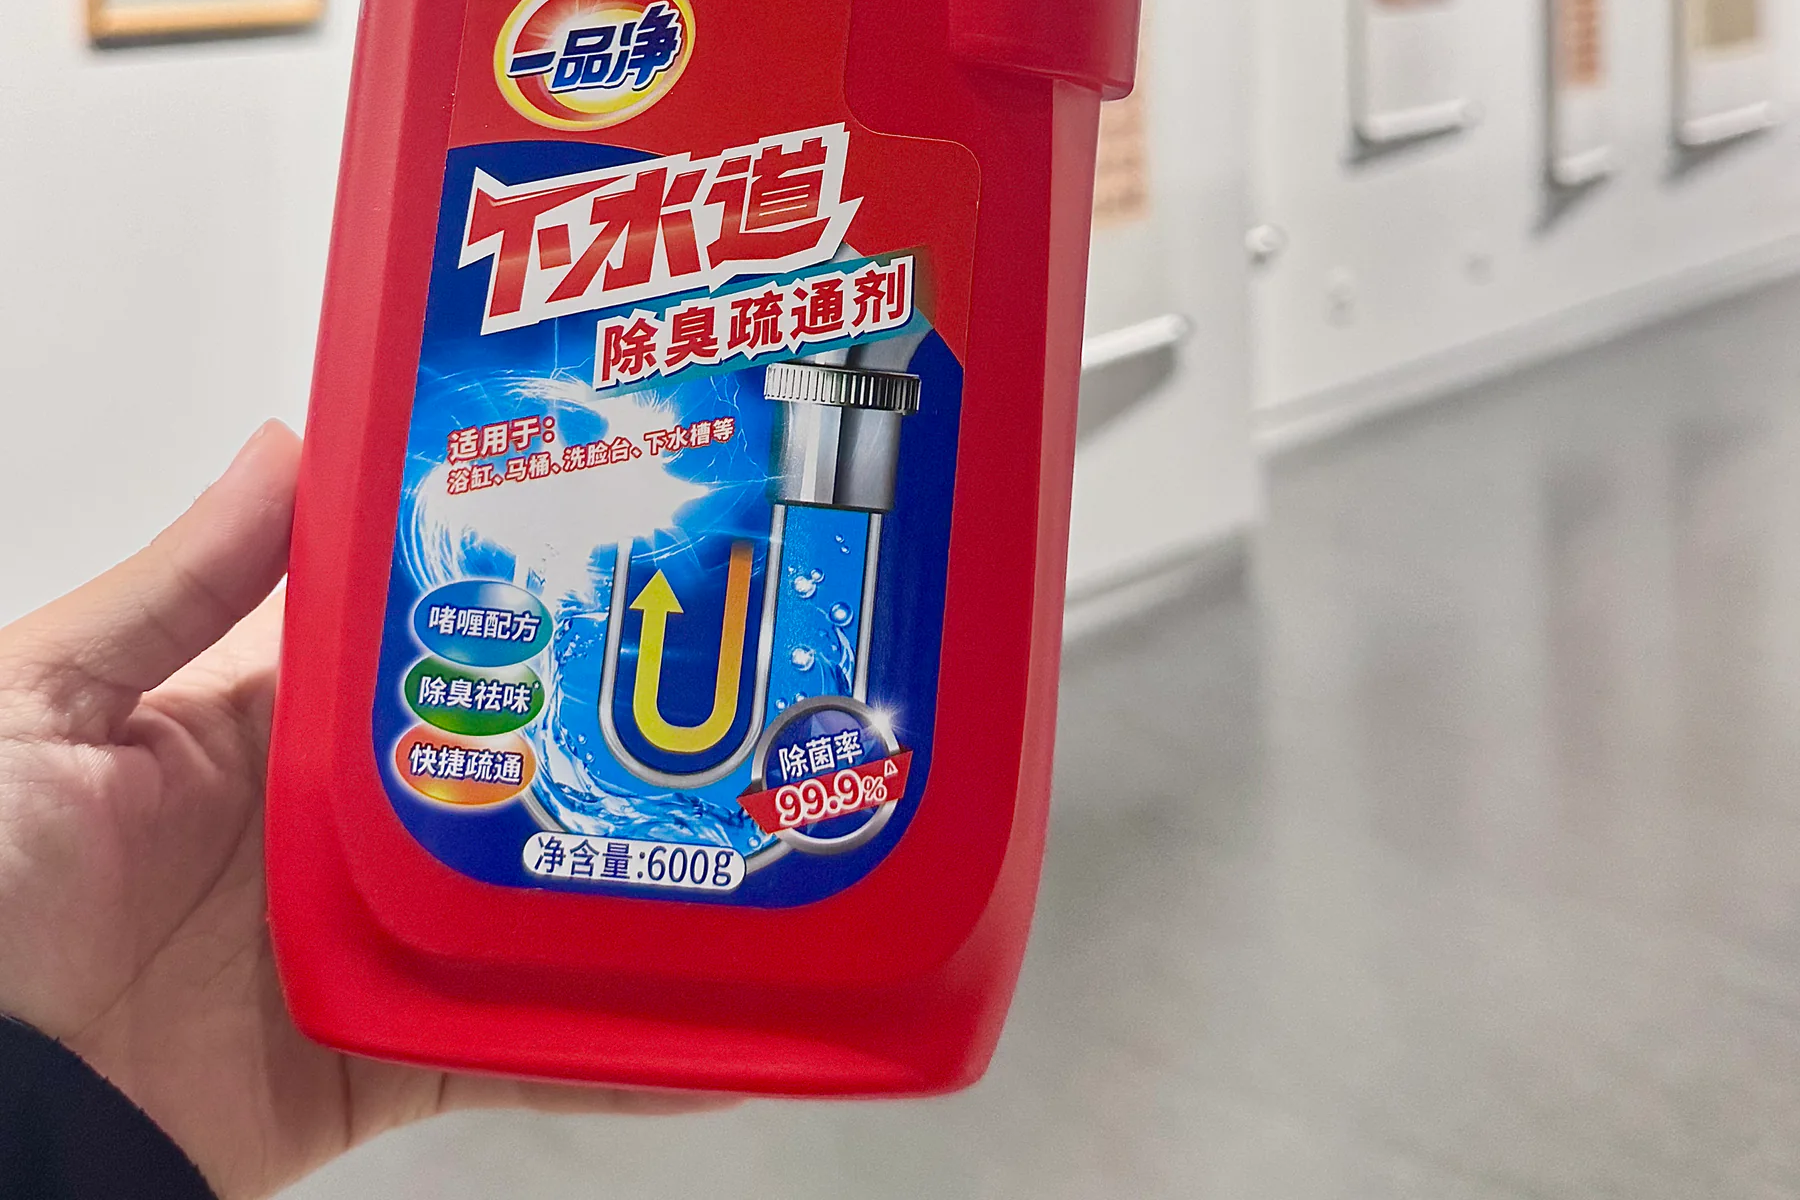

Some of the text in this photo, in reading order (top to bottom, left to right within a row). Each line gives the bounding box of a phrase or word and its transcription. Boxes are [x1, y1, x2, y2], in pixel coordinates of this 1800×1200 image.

[506, 1, 682, 93] 一品净
[466, 138, 834, 319] 下水道
[602, 262, 908, 378] 除臭疏通剂
[447, 416, 735, 494] 浴缸、马桶、洗脸台、下水槽等
[428, 604, 540, 644] 啫喱配方
[418, 674, 532, 715] 除臭祛味
[409, 742, 525, 785] 快捷疏通
[778, 730, 864, 781] 除菌率
[775, 768, 888, 826] 99.9%
[534, 835, 734, 887] 净含量:600g
